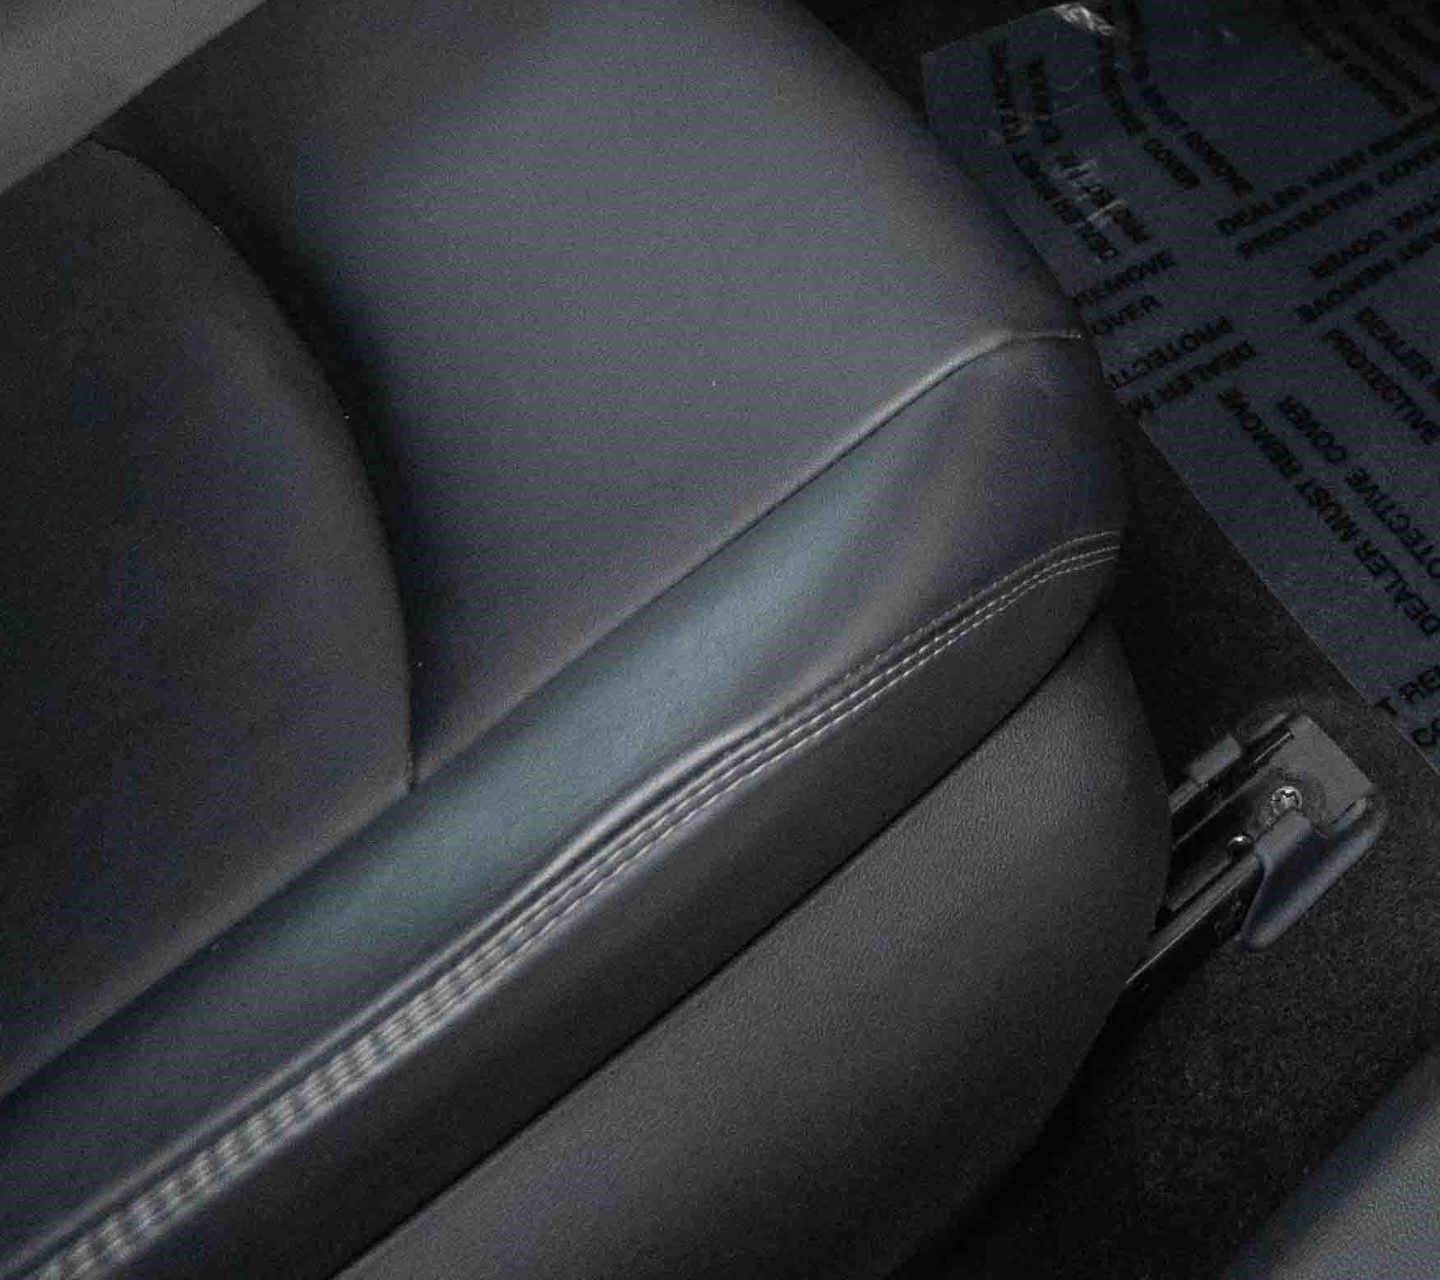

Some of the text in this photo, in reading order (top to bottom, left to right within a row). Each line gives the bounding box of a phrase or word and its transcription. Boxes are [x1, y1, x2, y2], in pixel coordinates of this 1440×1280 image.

[1072, 249, 1178, 309] REMOVE
[1090, 293, 1163, 337] OVER
[1354, 306, 1433, 380] DEALER
[1293, 478, 1360, 543] MUST
